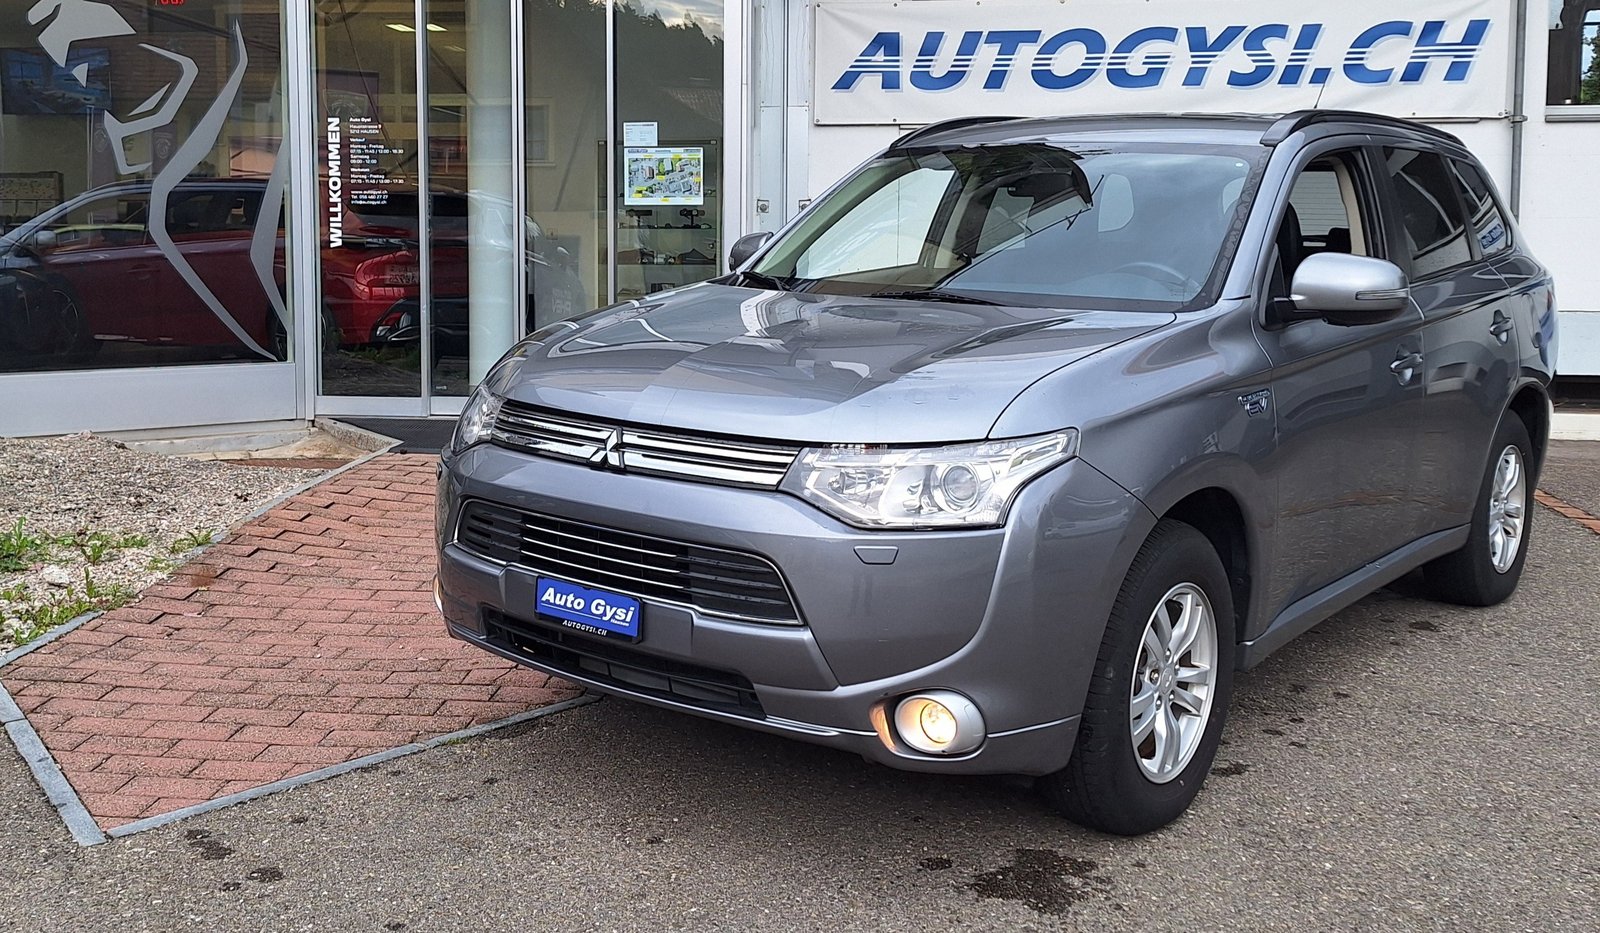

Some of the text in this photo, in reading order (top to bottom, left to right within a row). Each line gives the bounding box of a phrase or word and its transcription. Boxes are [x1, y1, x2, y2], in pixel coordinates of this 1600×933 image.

[831, 19, 1490, 92] AUTOGYSI.CH
[328, 117, 342, 248] WILLKOMMEN
[541, 587, 635, 622] Auto Gysi
[563, 620, 607, 636] AUTOGYSI.CH
